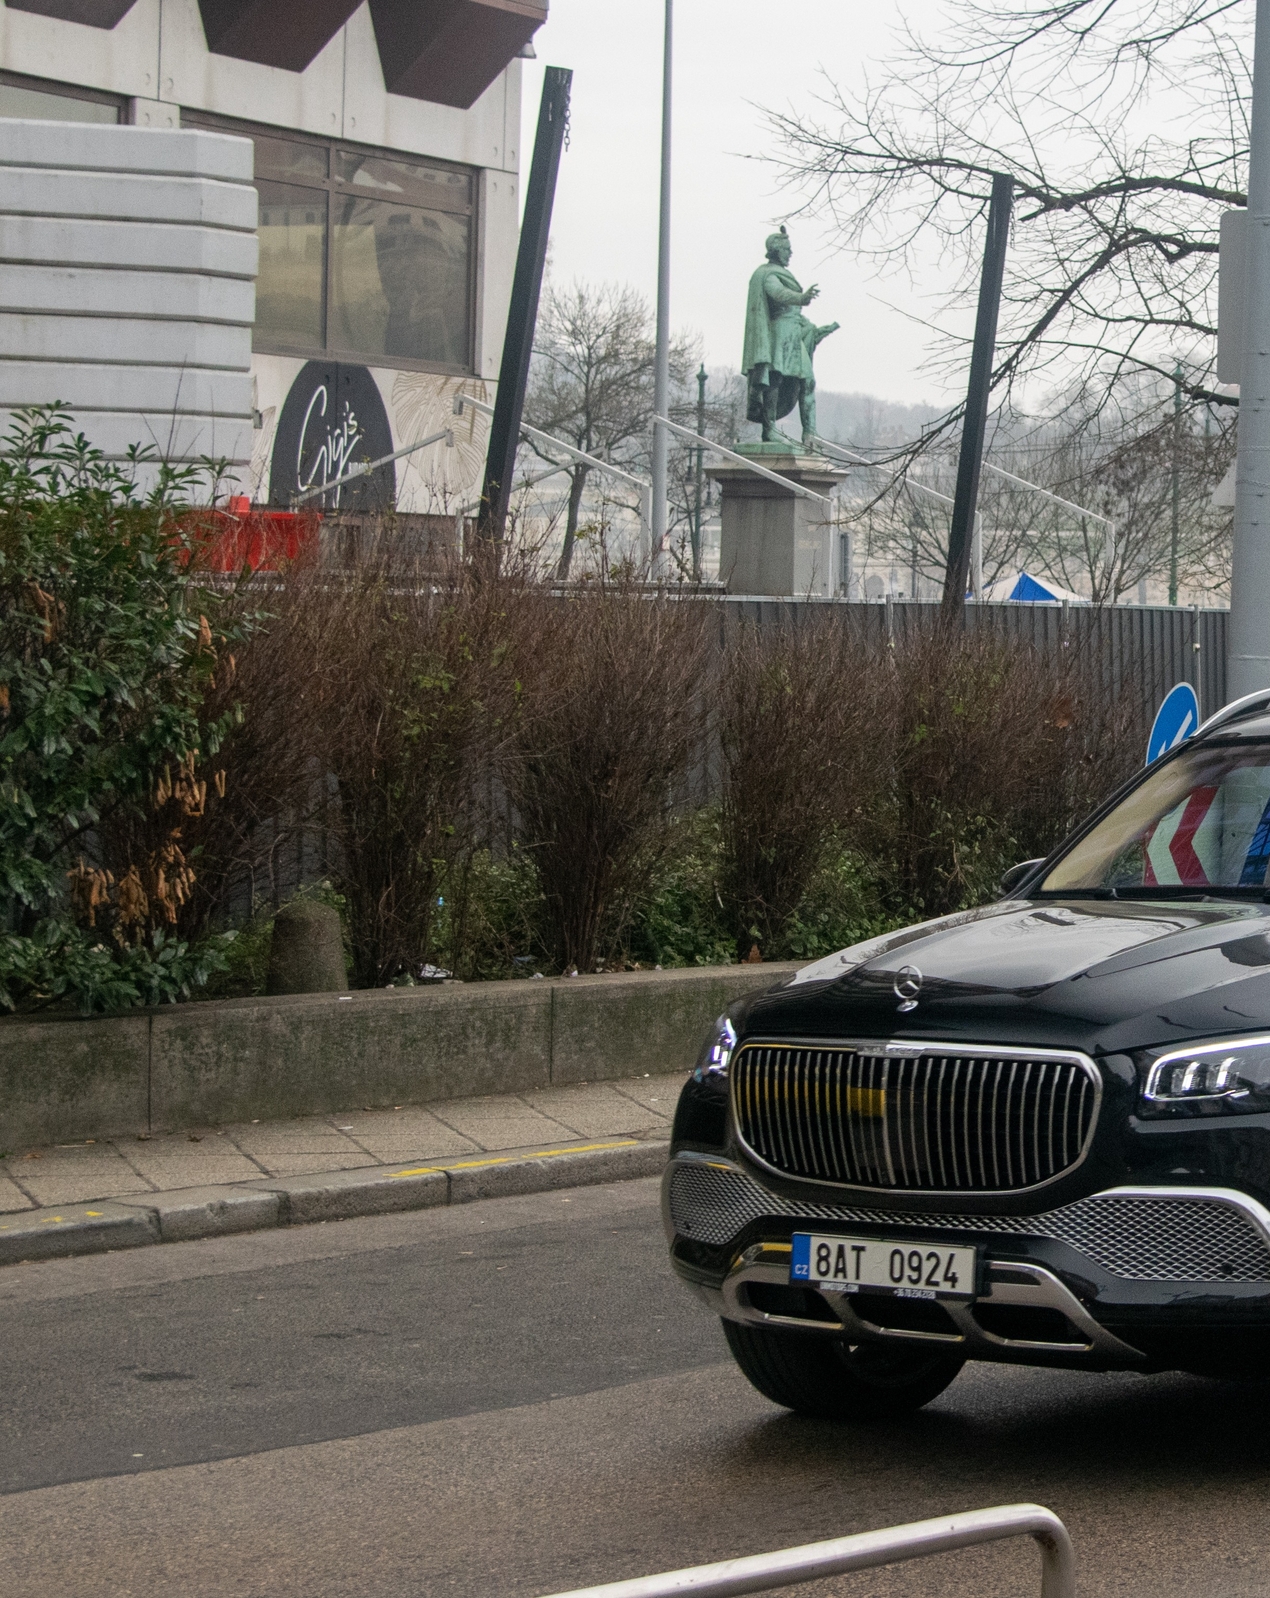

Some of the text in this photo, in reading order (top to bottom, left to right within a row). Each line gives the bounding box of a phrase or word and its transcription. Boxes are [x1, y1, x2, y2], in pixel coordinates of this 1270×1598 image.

[794, 1264, 809, 1276] CZ
[816, 1242, 959, 1289] 8AT 0924
